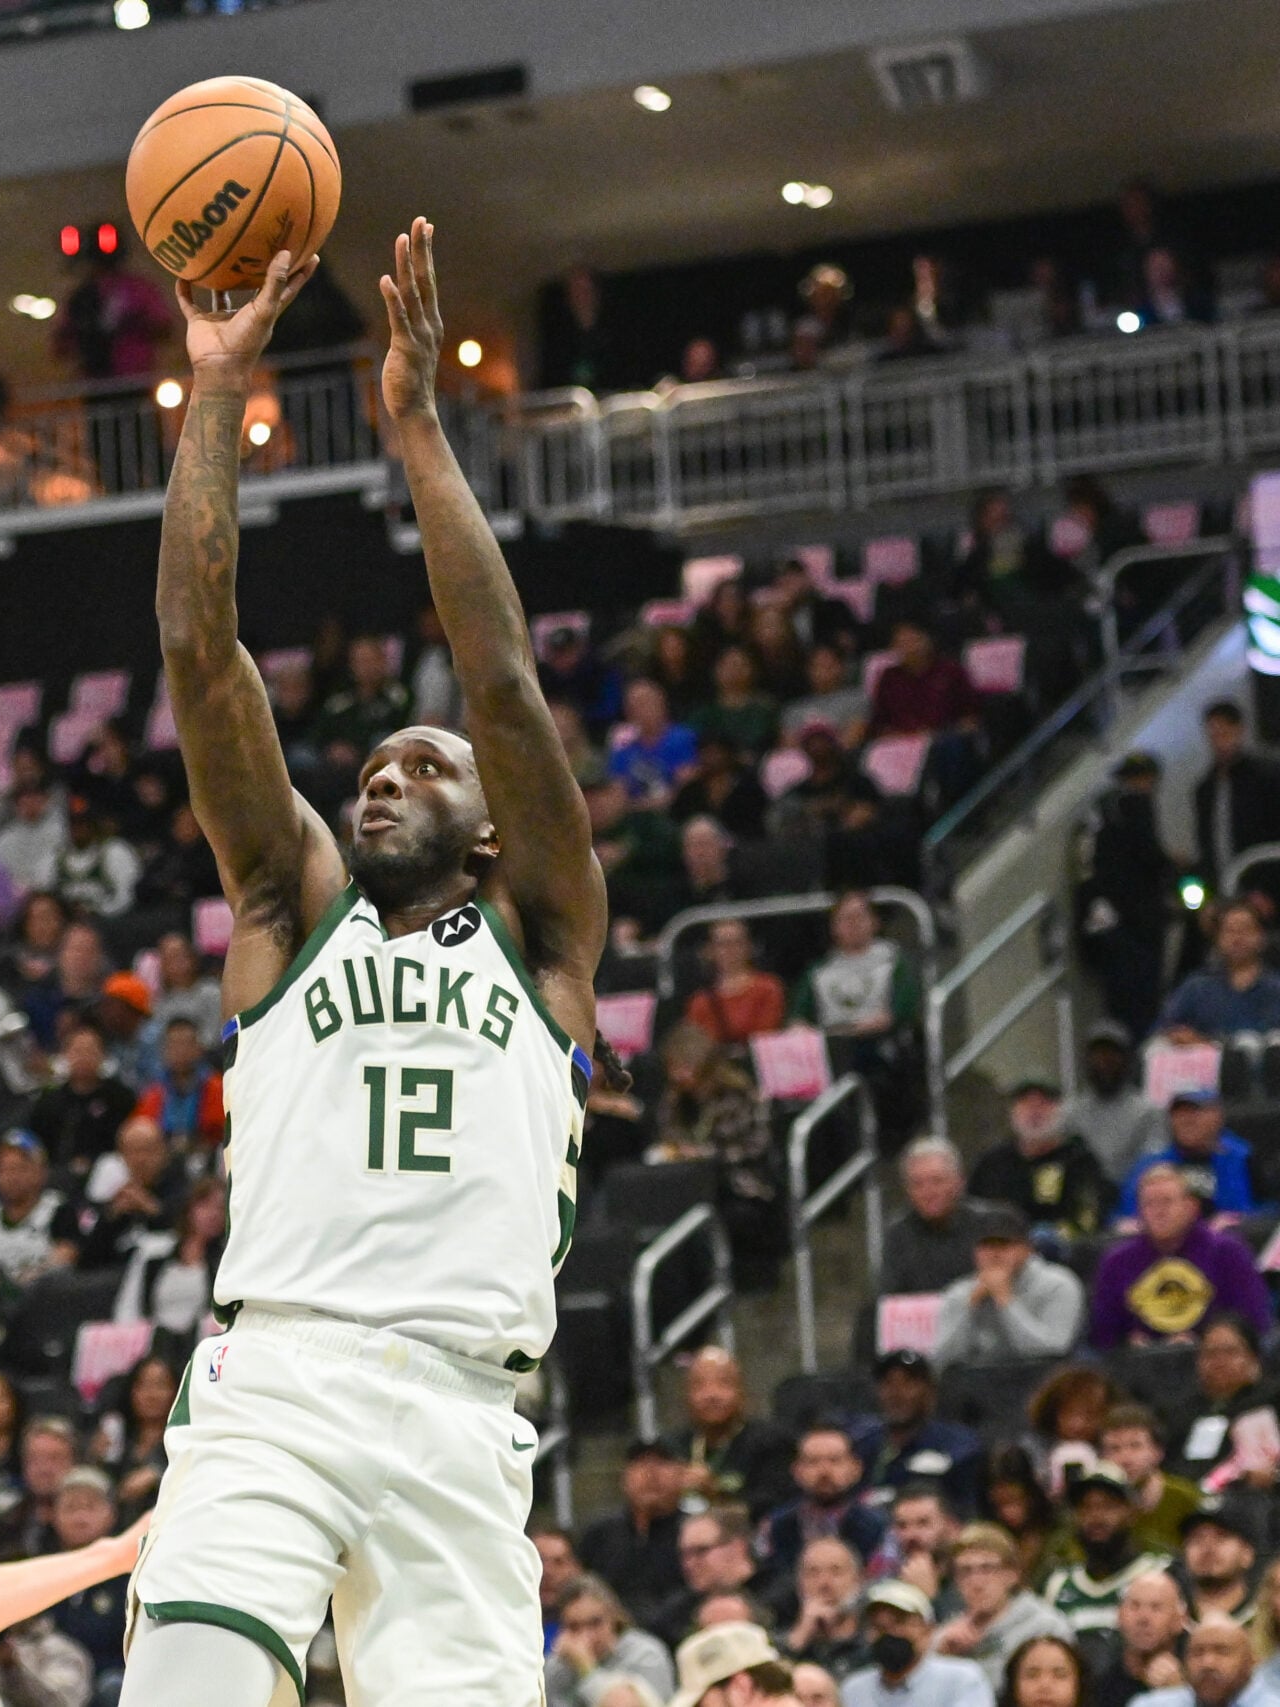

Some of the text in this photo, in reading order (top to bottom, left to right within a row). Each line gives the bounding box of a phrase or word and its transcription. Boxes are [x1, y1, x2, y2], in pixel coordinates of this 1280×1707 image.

[153, 179, 251, 272] Wilson
[304, 955, 520, 1052] BUCKS
[363, 1064, 455, 1174] 12
